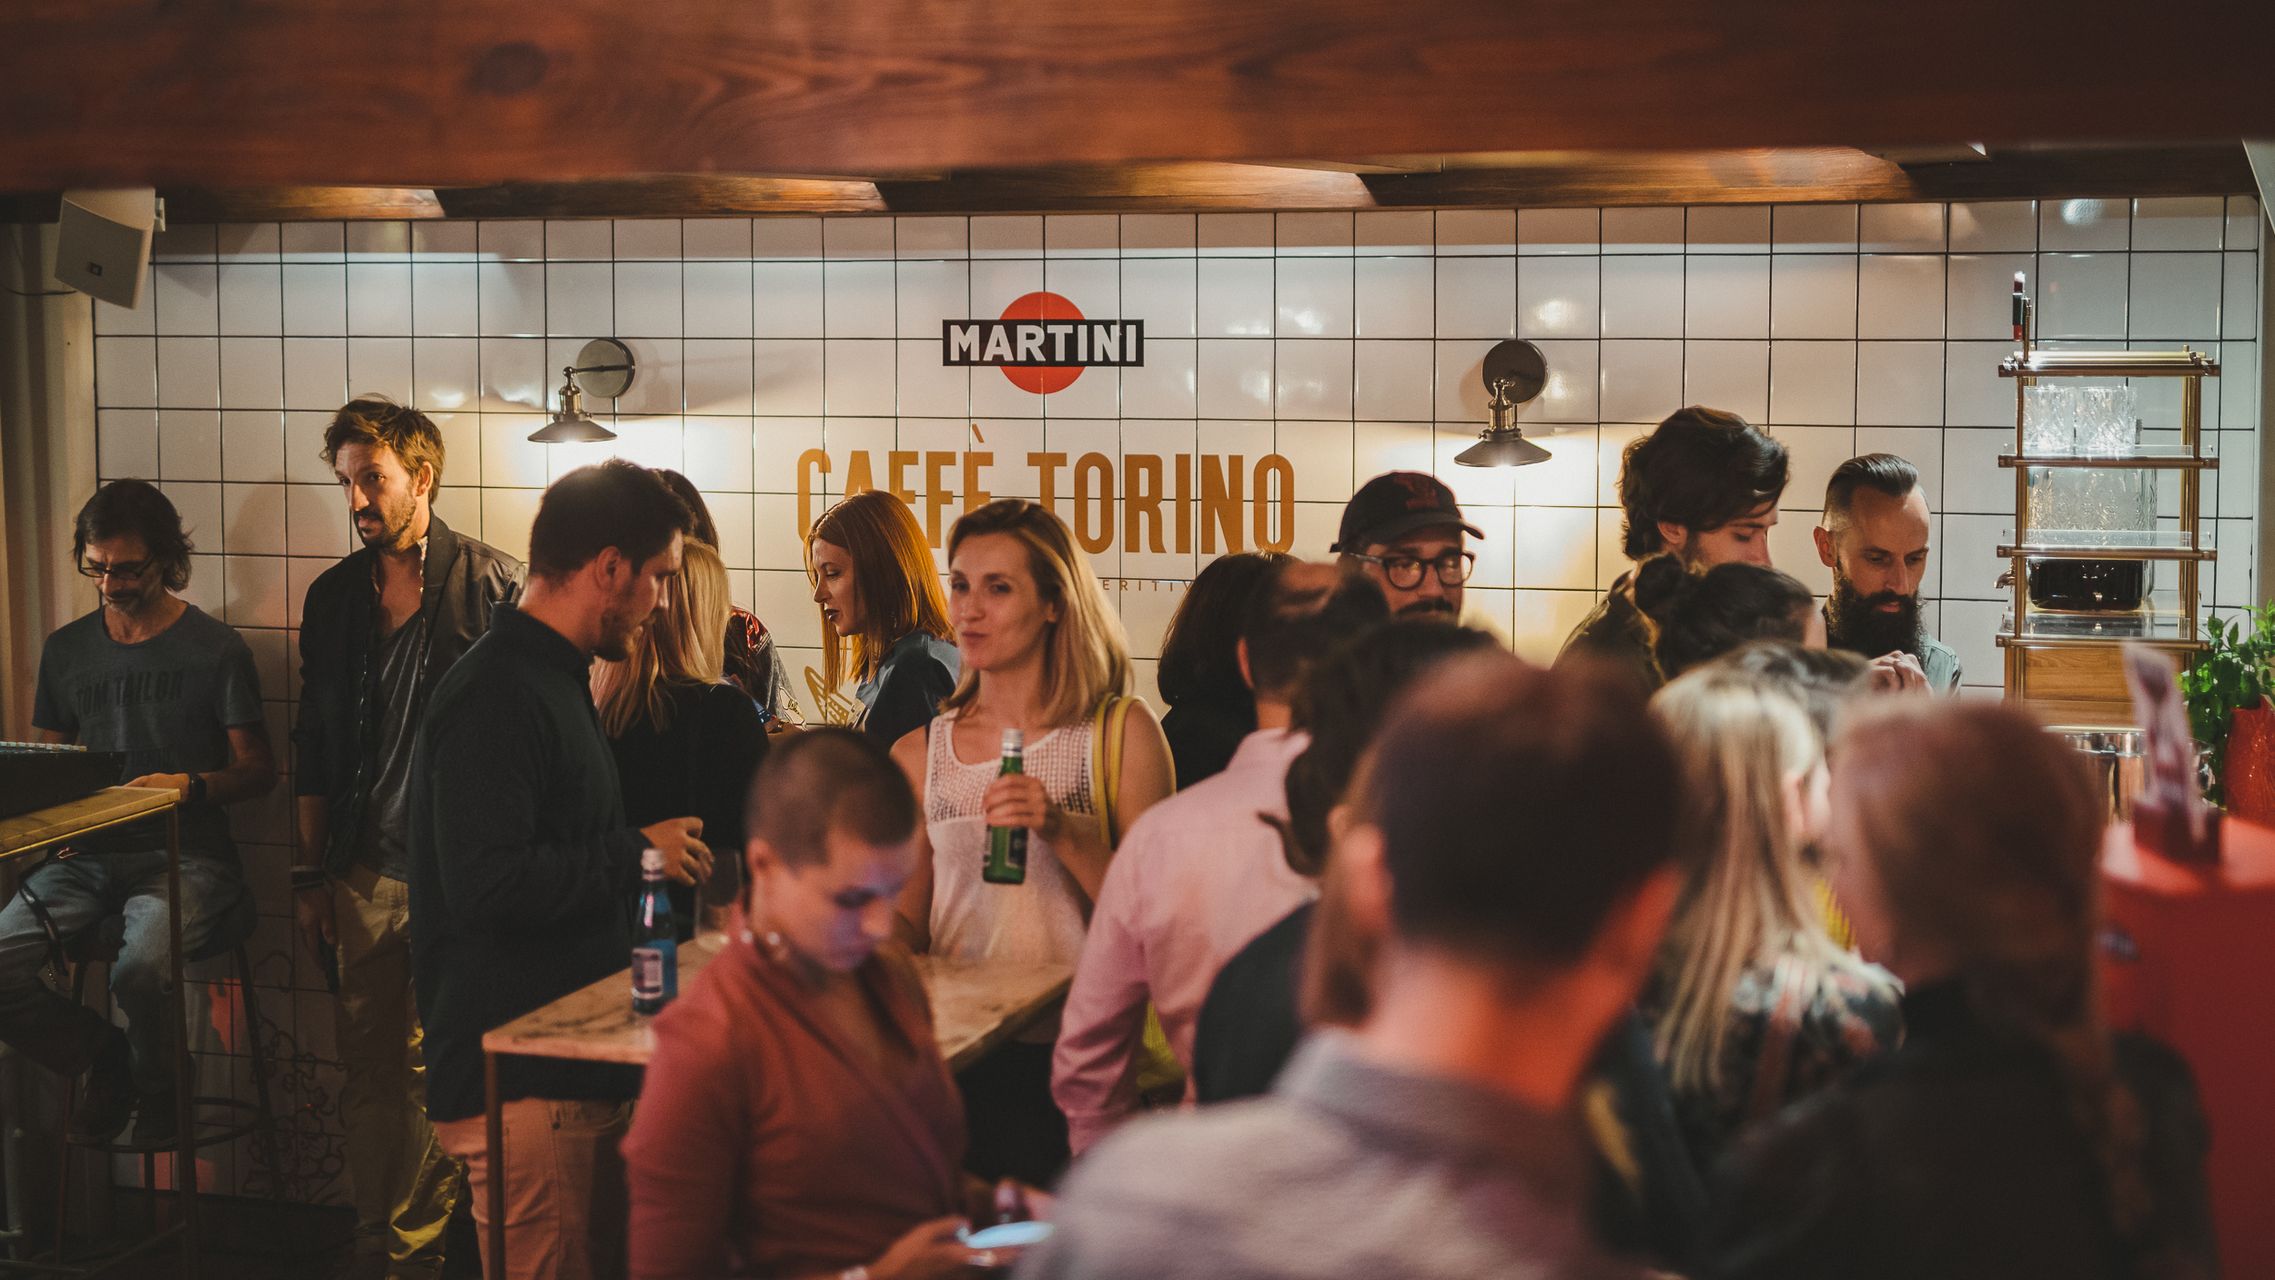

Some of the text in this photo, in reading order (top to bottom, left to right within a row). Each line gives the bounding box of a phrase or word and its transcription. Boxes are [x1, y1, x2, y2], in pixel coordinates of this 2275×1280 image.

[950, 324, 1138, 362] MARTINI
[1027, 451, 1295, 555] TORINO
[1102, 580, 1194, 592] ERITIV
